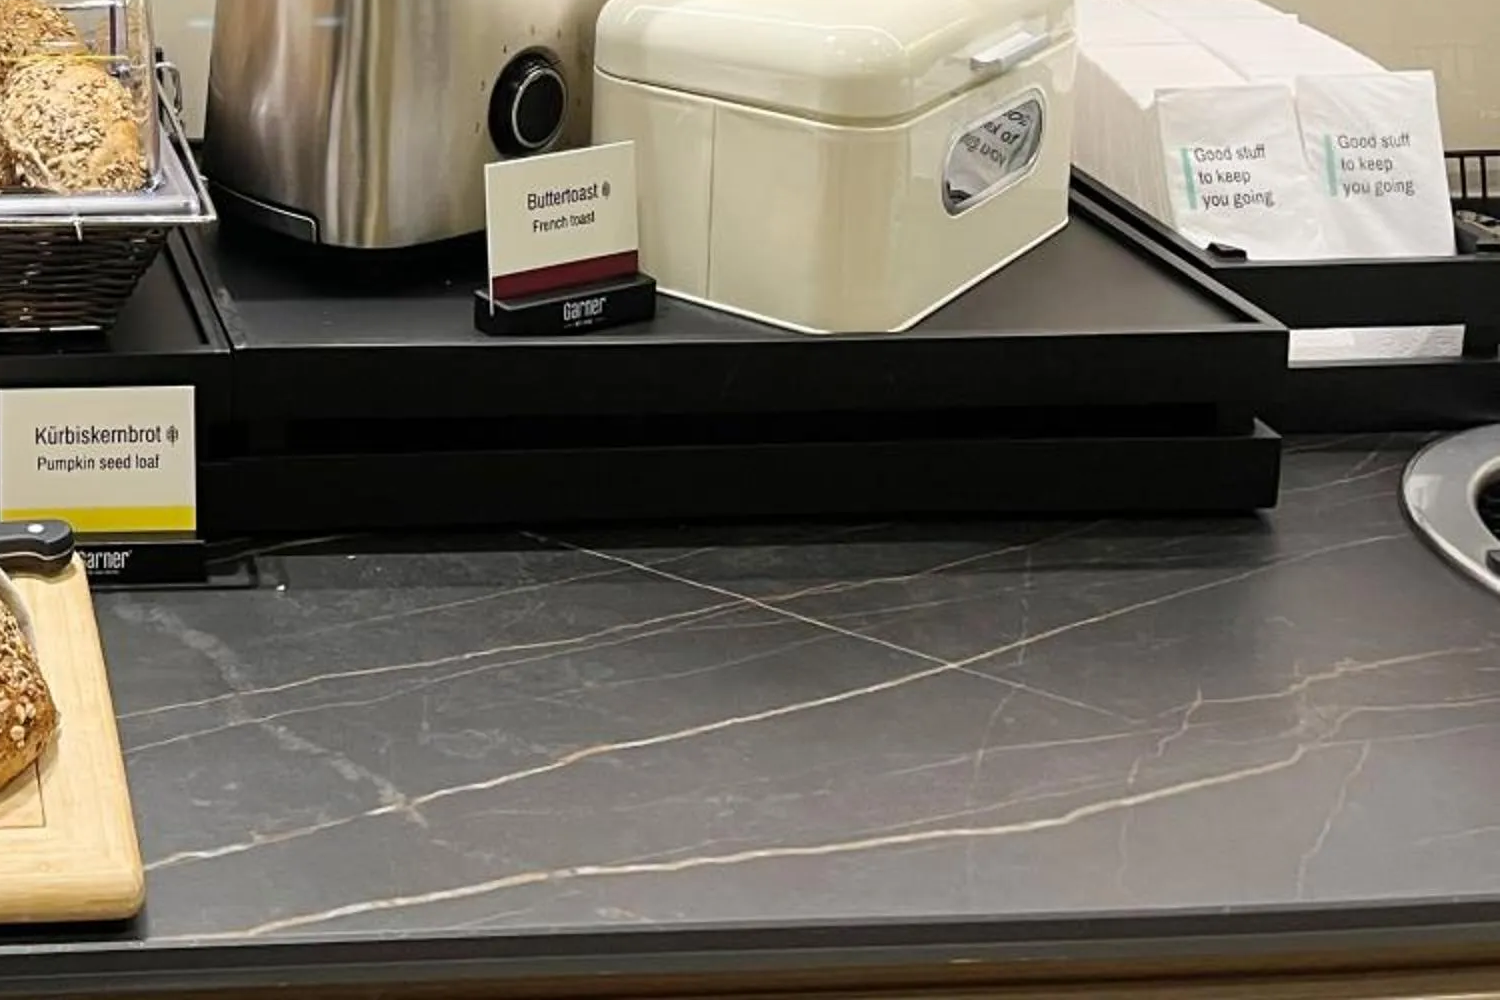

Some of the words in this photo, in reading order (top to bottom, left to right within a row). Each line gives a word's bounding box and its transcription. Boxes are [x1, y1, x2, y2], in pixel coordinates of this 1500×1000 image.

[1336, 134, 1377, 150] Good
[1381, 133, 1411, 147] stuff
[1194, 147, 1233, 163] Good
[1235, 144, 1266, 159] stuff
[1340, 158, 1355, 171] to
[1359, 157, 1393, 172] keep
[1198, 169, 1213, 185] to
[1215, 168, 1251, 185] keep
[527, 184, 600, 211] Buttertoast
[1342, 180, 1371, 197] you
[1374, 179, 1416, 197] going
[1202, 194, 1230, 209] you
[1233, 190, 1275, 209] going
[533, 216, 569, 233] French
[569, 211, 596, 227] toast
[563, 296, 606, 322] Garner
[35, 424, 162, 446] Kürbiskernbrot
[36, 456, 95, 473] Pumpkin
[99, 455, 132, 470] seed
[135, 454, 161, 469] loaf
